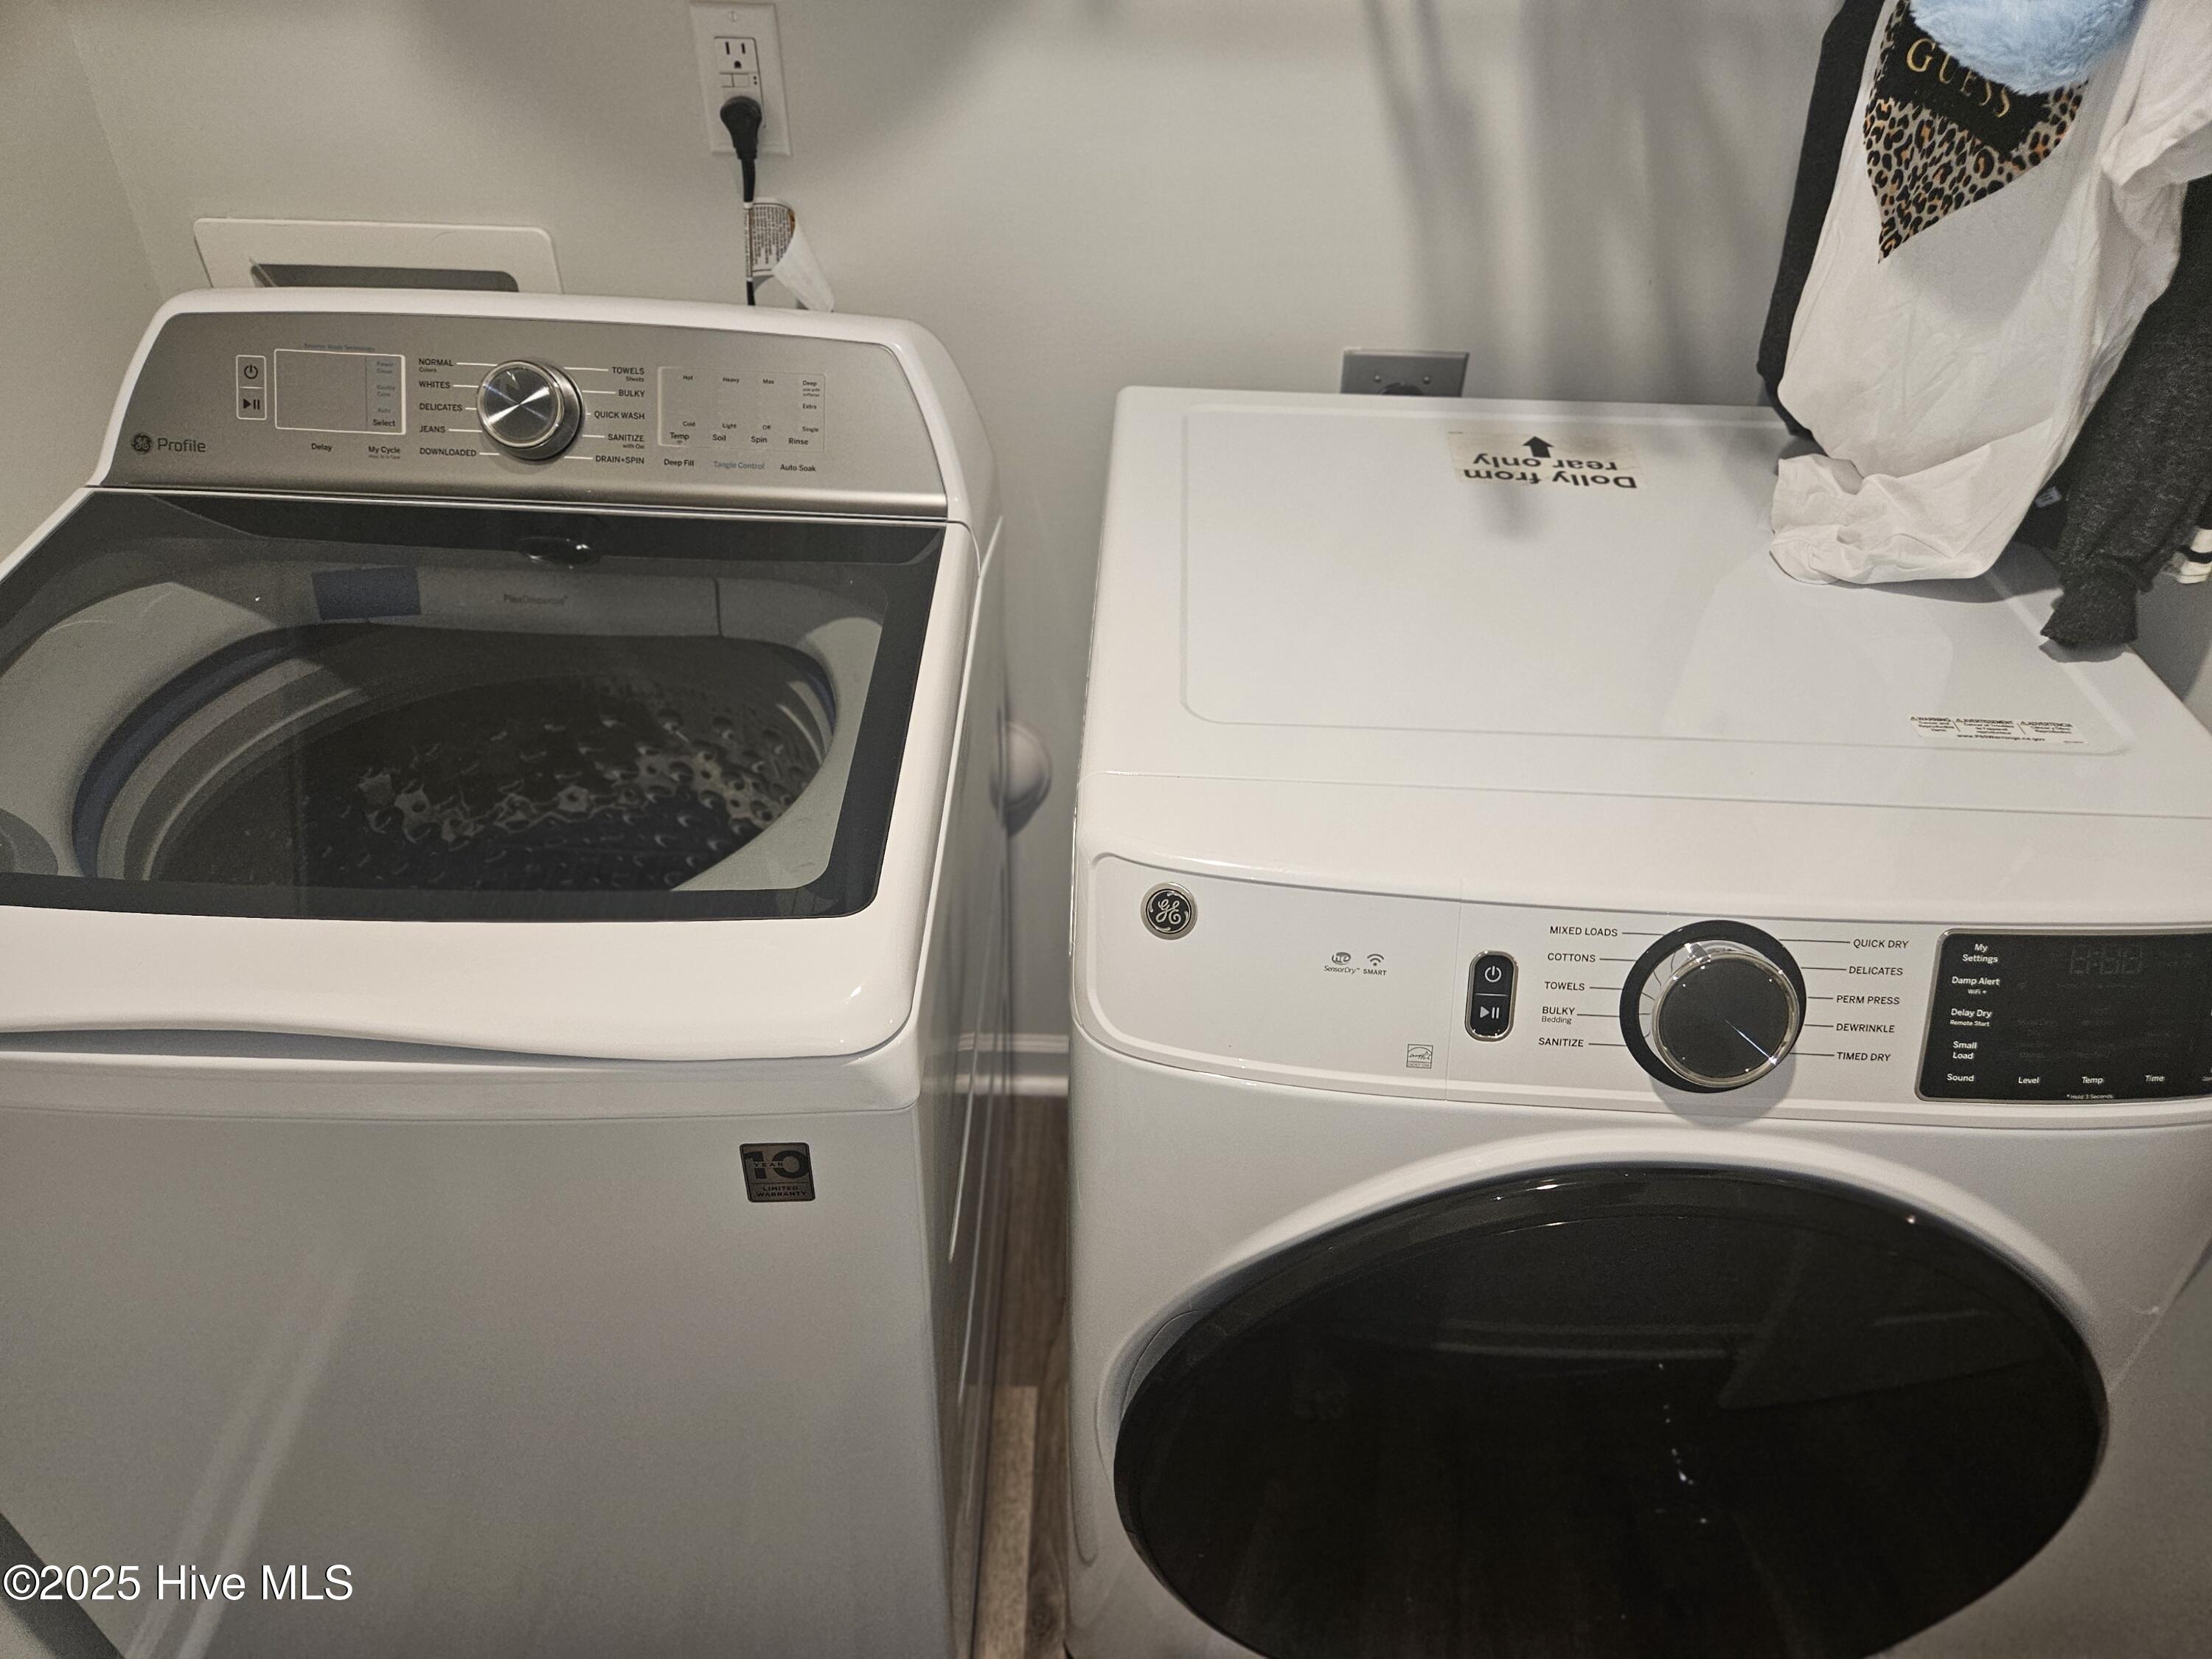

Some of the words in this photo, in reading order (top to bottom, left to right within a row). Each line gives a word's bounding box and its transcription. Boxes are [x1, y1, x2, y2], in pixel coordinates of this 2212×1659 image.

[419, 358, 454, 366] NORMAL
[612, 366, 645, 375] TOWELS
[419, 380, 451, 389] WHITES
[619, 389, 646, 397] BULKY
[419, 403, 463, 411] DELICATES
[594, 410, 619, 419] QUICK
[372, 419, 396, 427] Select
[419, 425, 446, 434] JEANS
[608, 434, 645, 442] SANITIZE
[669, 431, 690, 441] Temp
[712, 434, 726, 442] Soil
[751, 436, 768, 444] Spin
[157, 438, 206, 453] Profile
[788, 437, 809, 445] Rinse
[311, 442, 333, 452] Delay
[369, 445, 380, 454] My
[380, 446, 401, 454] Cycle
[420, 447, 477, 457] DOWNLOADED
[595, 455, 645, 465] DRAIN+SPIN
[664, 458, 683, 467] Deep
[684, 459, 695, 467] Fill
[1473, 453, 1542, 467] only
[1552, 459, 1618, 470] rear
[714, 461, 737, 470] Tangle
[737, 462, 765, 470] Control
[799, 464, 816, 472] Soak
[1464, 469, 1542, 484] from
[1552, 470, 1638, 489] Dolly
[1549, 925, 1582, 936] MIXED
[1585, 927, 1618, 937] LOADS
[1853, 939, 1885, 949] QUICK
[1888, 940, 1909, 949] DRY
[1974, 943, 1989, 953] My
[1547, 953, 1596, 963] COTTONS
[1962, 953, 1999, 964] Settings
[1363, 968, 1387, 976] SMART
[1848, 966, 1904, 976] DELICATES
[1951, 975, 1977, 986] Damp
[1978, 977, 2000, 986] Alert
[1545, 981, 1585, 991] TOWELS
[1836, 995, 1865, 1004] PERM
[1867, 996, 1900, 1005] PRESS
[1542, 1006, 1576, 1015] BULKY
[1950, 1008, 1975, 1018] Delay
[1976, 1009, 1992, 1019] Dry
[1541, 1015, 1572, 1025] Bedding
[1836, 1023, 1896, 1033] DEWRINKLE
[1538, 1037, 1585, 1048] SANITIZE
[1952, 1040, 1978, 1049] Small
[1836, 1051, 1868, 1061] TIMED
[1870, 1053, 1891, 1062] DRY
[1952, 1051, 1975, 1060] Load
[1946, 1073, 1975, 1082] Sound
[2018, 1076, 2040, 1085] Level
[2081, 1076, 2104, 1085] Temp
[2145, 1074, 2166, 1082] Time
[743, 1150, 810, 1179] 10
